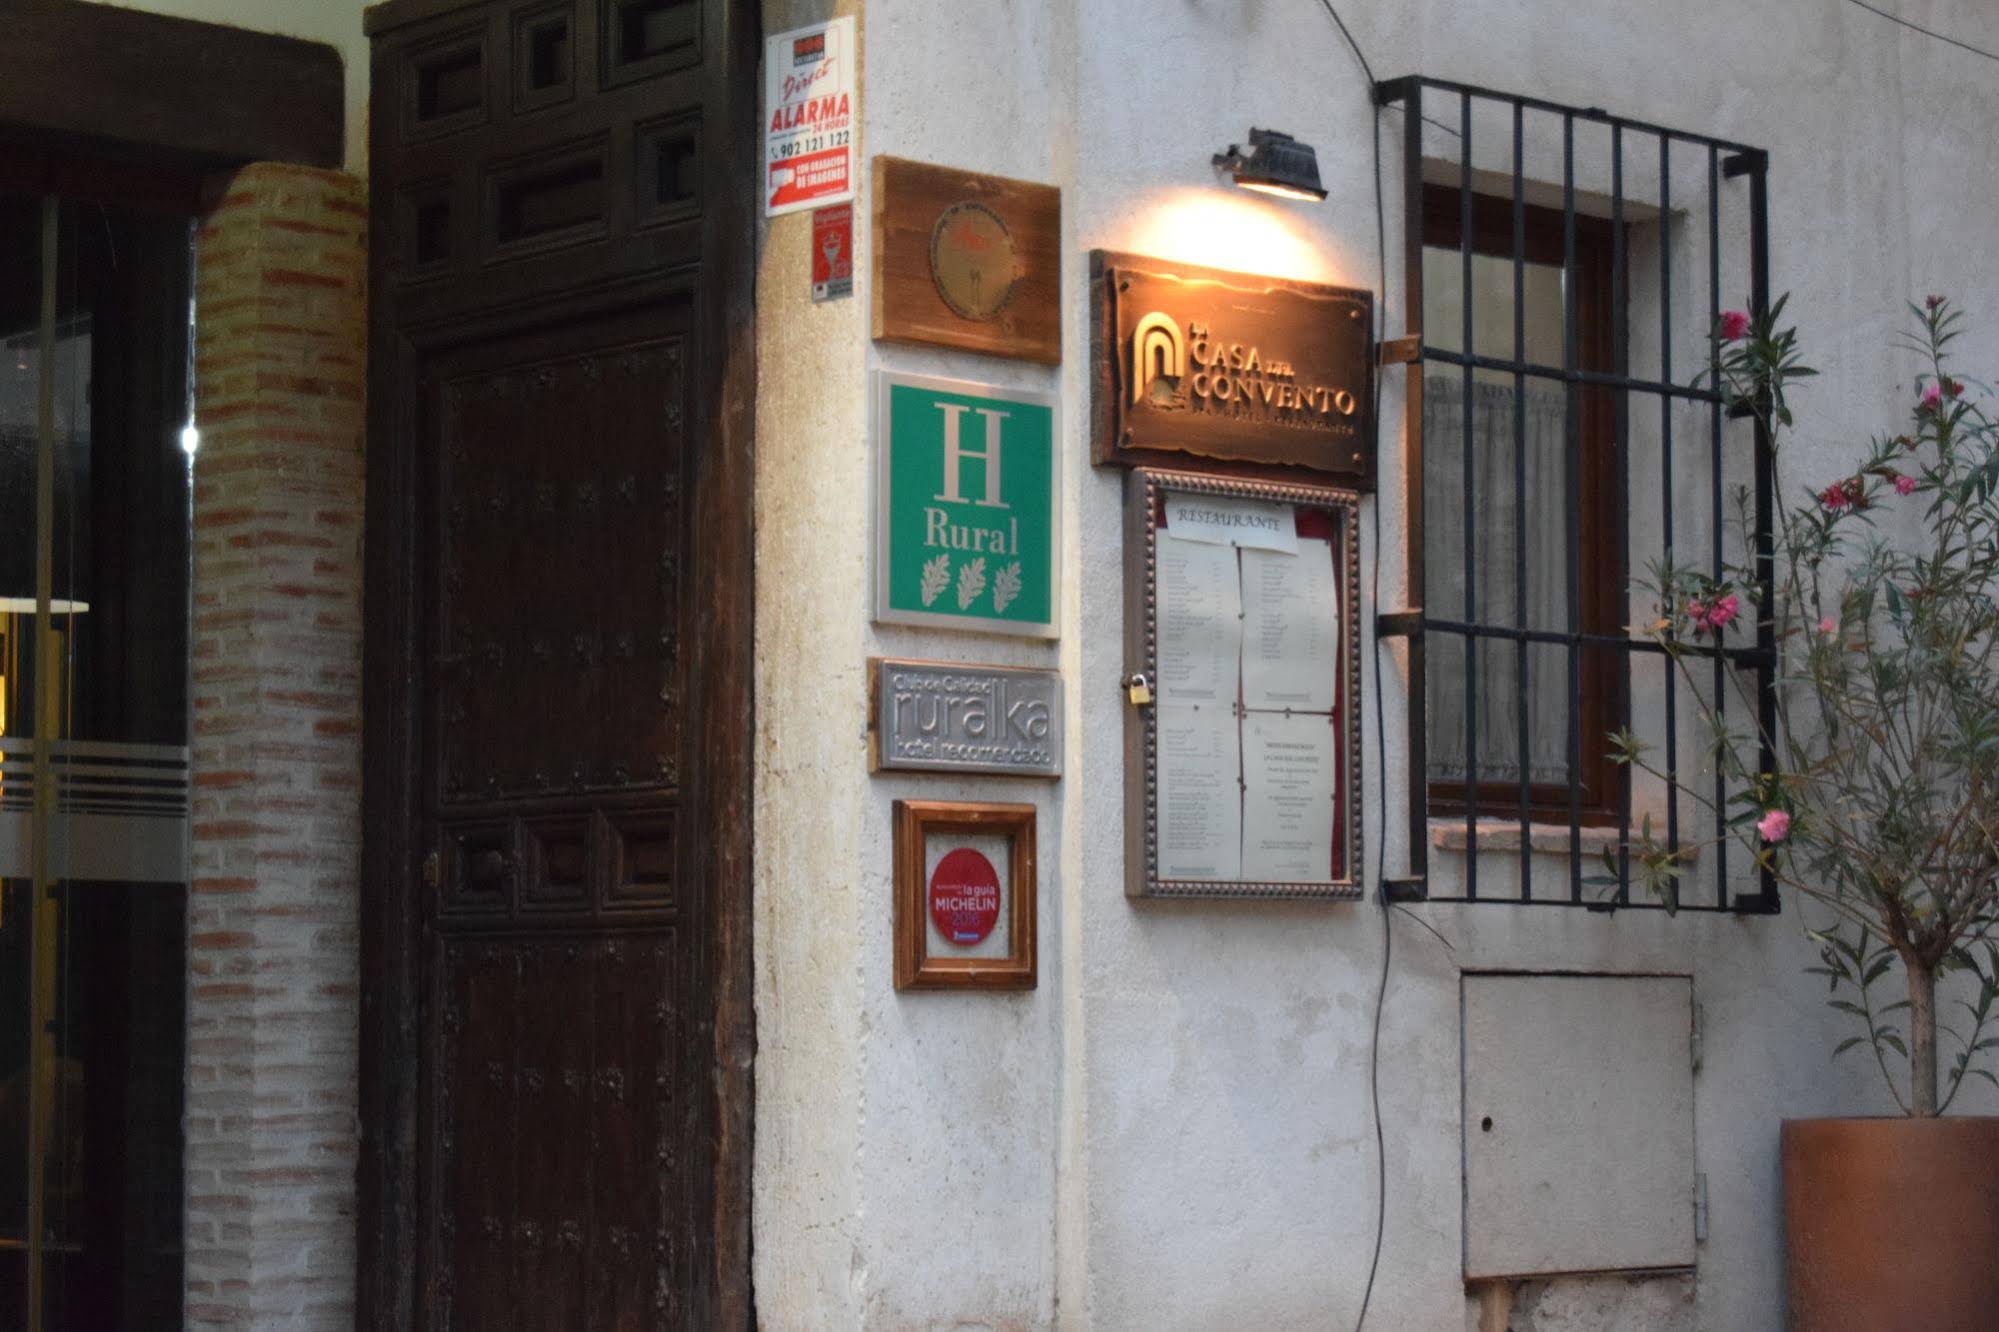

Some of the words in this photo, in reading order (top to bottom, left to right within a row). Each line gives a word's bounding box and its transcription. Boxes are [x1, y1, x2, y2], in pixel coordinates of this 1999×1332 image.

[783, 56, 836, 101] Direct
[770, 92, 849, 132] ALARMA
[812, 121, 823, 134] 24
[780, 141, 800, 158] 902
[805, 136, 823, 152] 121
[830, 130, 849, 147] 122
[1192, 340, 1263, 374] CASA
[1192, 373, 1356, 416] CONVENTO
[934, 402, 1010, 509] H
[923, 507, 1019, 555] Rural
[1176, 508, 1282, 532] RESTAURANTE
[894, 677, 1050, 742] ruralka
[940, 740, 1050, 764] recomendado
[935, 897, 997, 911] MICHELIN
[963, 885, 973, 896] la
